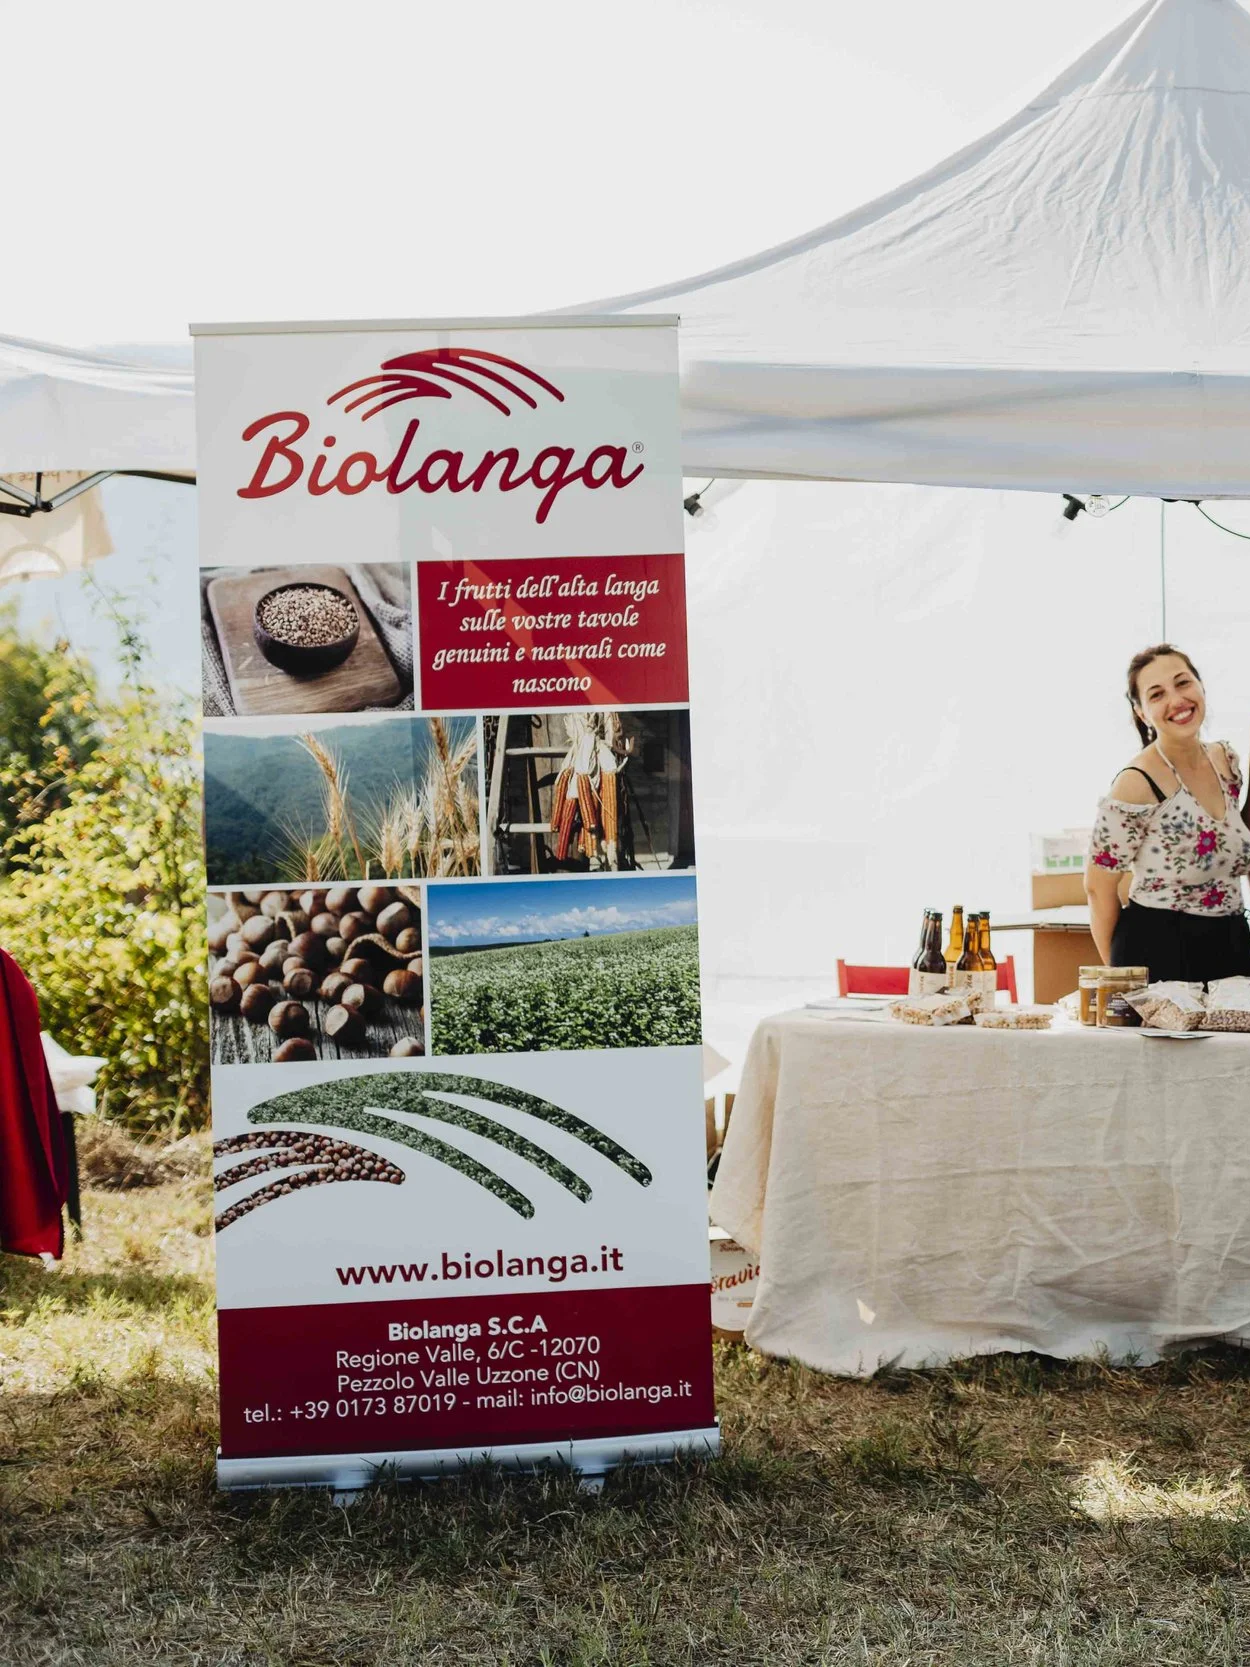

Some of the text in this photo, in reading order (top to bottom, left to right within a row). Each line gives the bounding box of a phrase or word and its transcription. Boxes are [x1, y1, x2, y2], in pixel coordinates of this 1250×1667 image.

[437, 574, 660, 605] I frutti dell'alta langa
[460, 606, 639, 631] sulle vostre tavole
[432, 637, 666, 670] genuini e naturali come
[512, 675, 591, 693] nascono
[336, 1245, 623, 1286] www.biolanga.it
[388, 1315, 547, 1344] Biolanga S.C.A
[336, 1336, 600, 1373] Regione Valle, 6/C -12070
[338, 1360, 600, 1394] Pezzolo Valle Uzzone (CN)
[244, 1407, 282, 1424] tel.:
[289, 1401, 329, 1420] +39
[336, 1399, 386, 1418] 0173
[394, 1394, 456, 1414] 87019
[476, 1389, 524, 1409] mail:
[531, 1381, 692, 1407] info@biolanga.it
